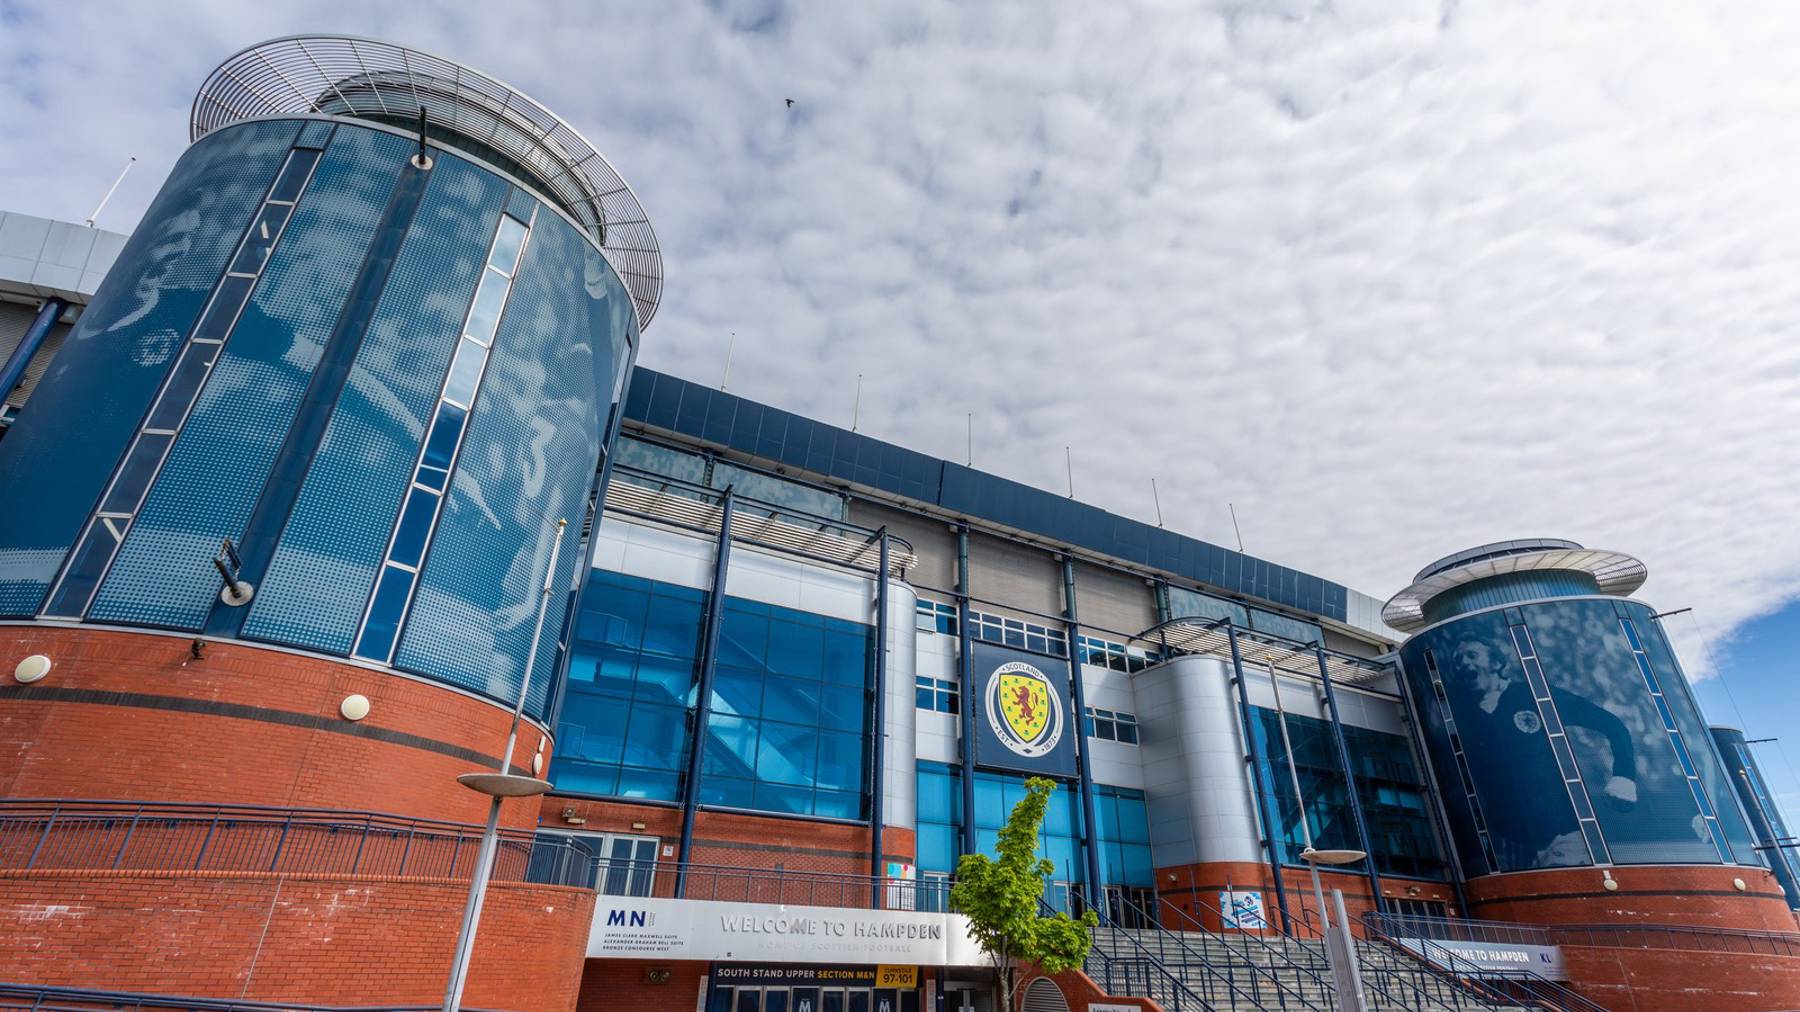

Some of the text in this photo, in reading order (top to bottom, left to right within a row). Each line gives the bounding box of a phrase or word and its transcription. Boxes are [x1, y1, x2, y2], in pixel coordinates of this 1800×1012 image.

[1005, 663, 1040, 677] SCOTLAND
[1043, 737, 1056, 751] 1873
[607, 909, 646, 927] MN
[720, 915, 817, 935] WELCOME
[823, 919, 845, 937] TO
[854, 921, 941, 939] HAMPDEN
[863, 943, 912, 952] FOOTBALL
[1476, 950, 1487, 961] TO
[1488, 950, 1530, 962] HAMPDEN
[1540, 953, 1552, 963] KL
[718, 968, 875, 979] SOUTH STAND UPPER SECTION M&N
[883, 973, 913, 984] 97-101
